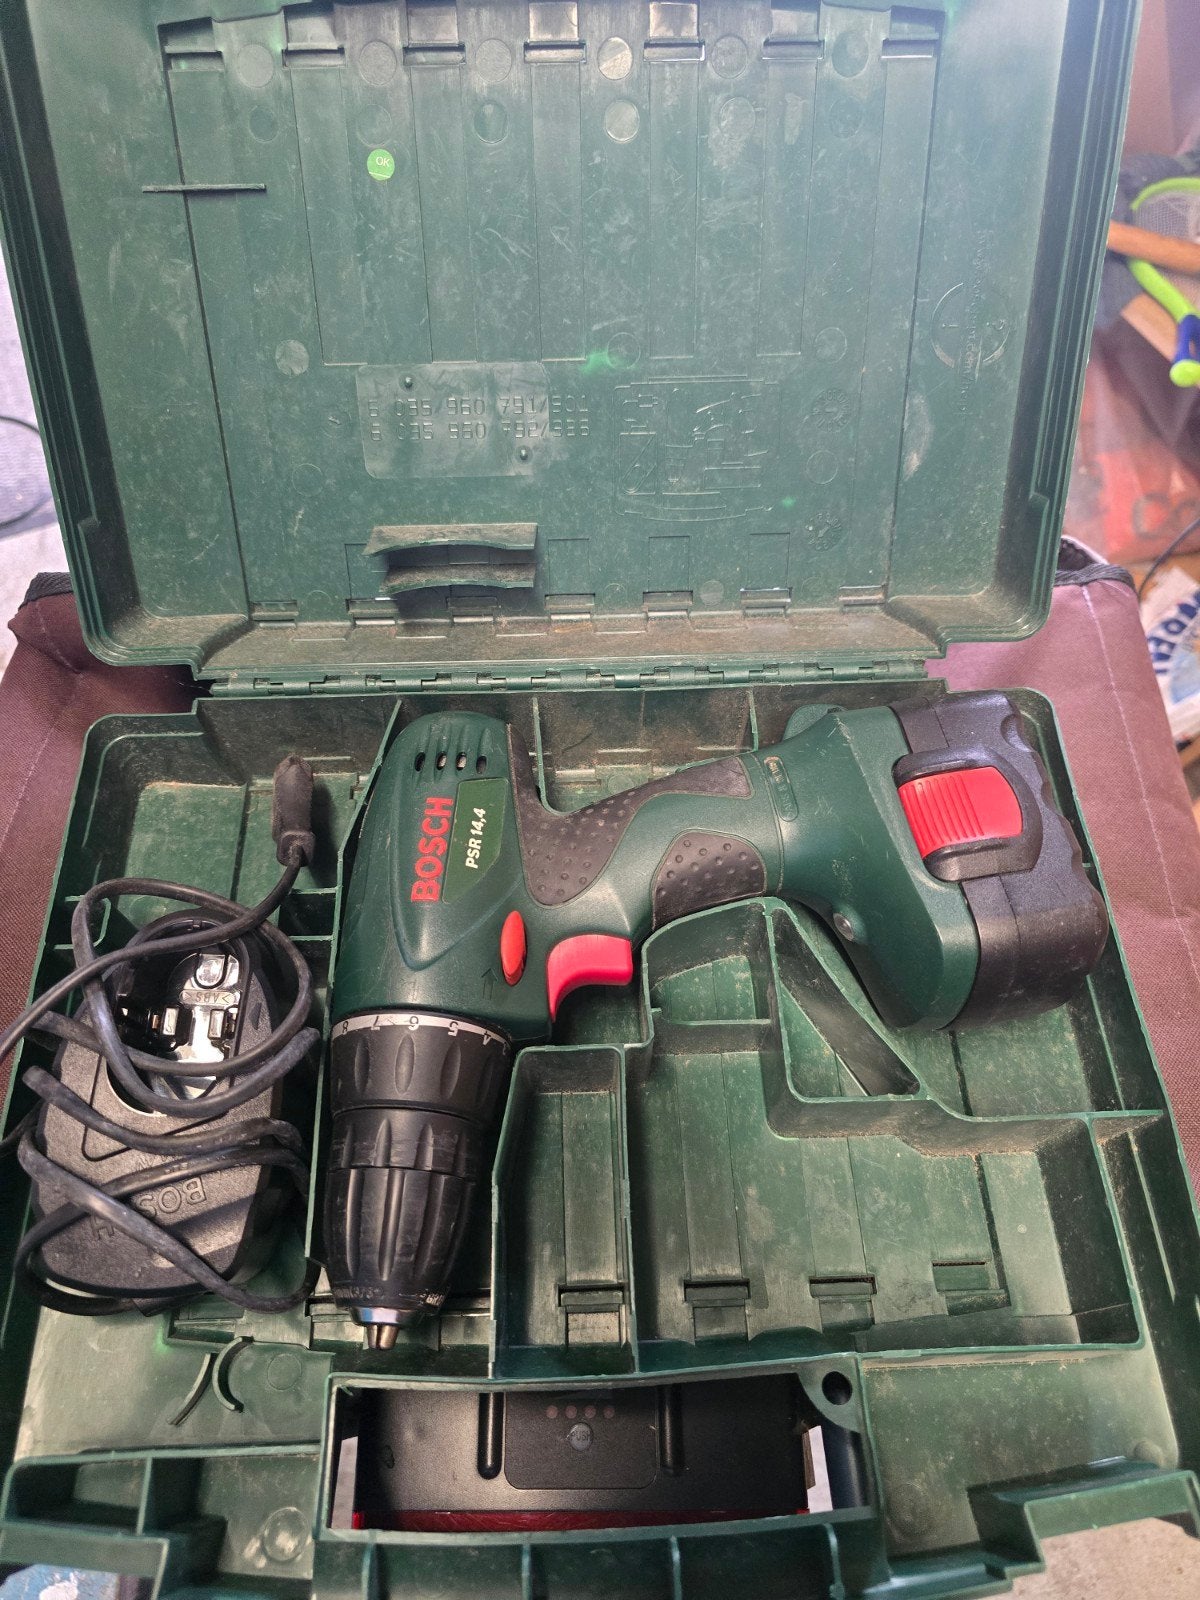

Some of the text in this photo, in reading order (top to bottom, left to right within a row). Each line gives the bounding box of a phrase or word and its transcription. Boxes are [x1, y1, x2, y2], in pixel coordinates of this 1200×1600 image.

[375, 156, 391, 168] OK
[465, 807, 487, 869] PSR 14,4
[411, 796, 454, 903] BOSCH
[371, 1015, 381, 1031] 7
[408, 1015, 420, 1031] 6
[448, 1021, 459, 1037] 5
[482, 1030, 491, 1046] 4
